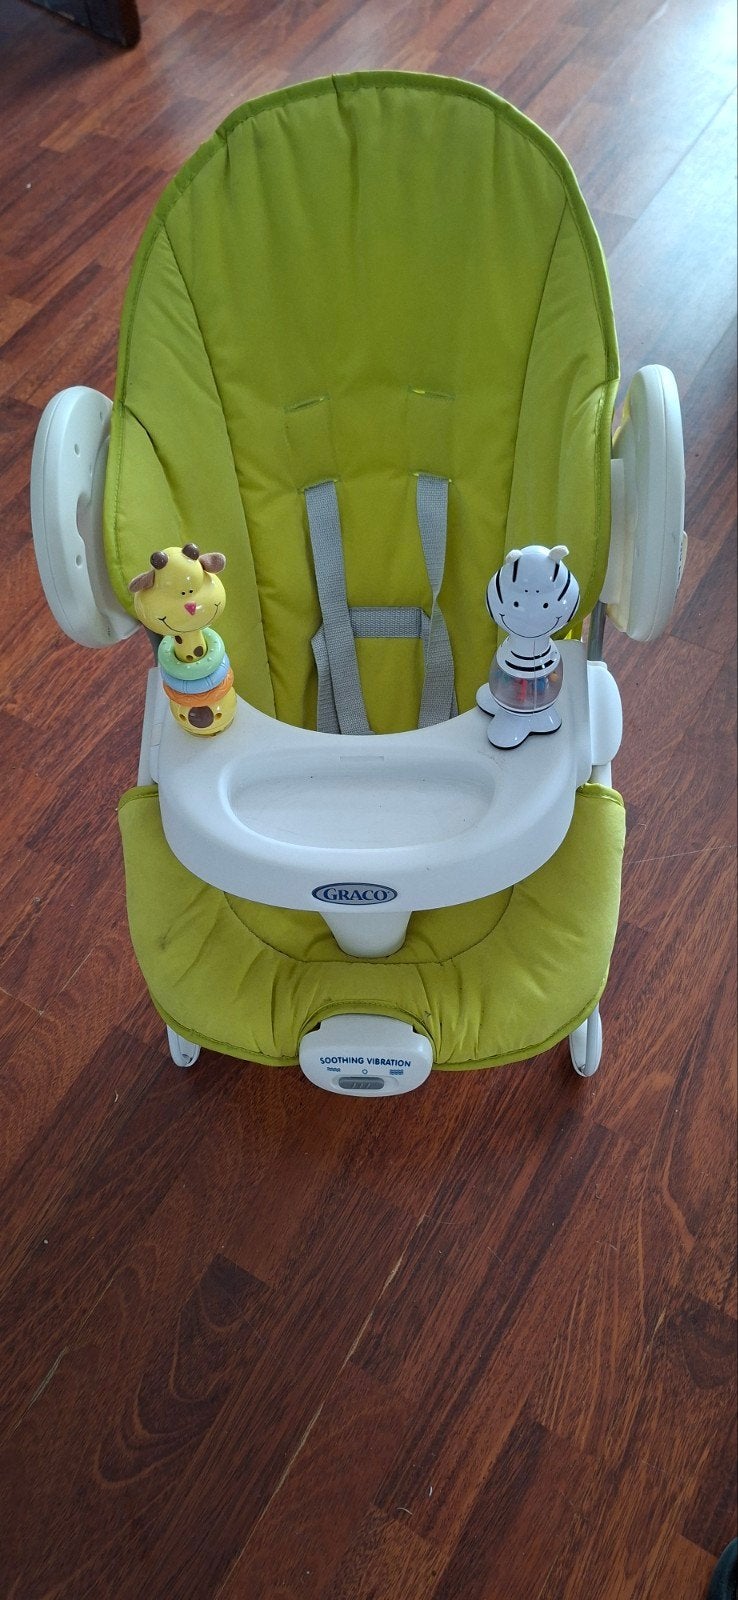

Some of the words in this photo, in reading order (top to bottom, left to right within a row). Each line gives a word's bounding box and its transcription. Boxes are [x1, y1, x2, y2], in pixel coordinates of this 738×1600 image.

[323, 888, 388, 901] GRACO
[319, 1056, 365, 1065] SOOTHING
[366, 1057, 412, 1067] VIBRATION
